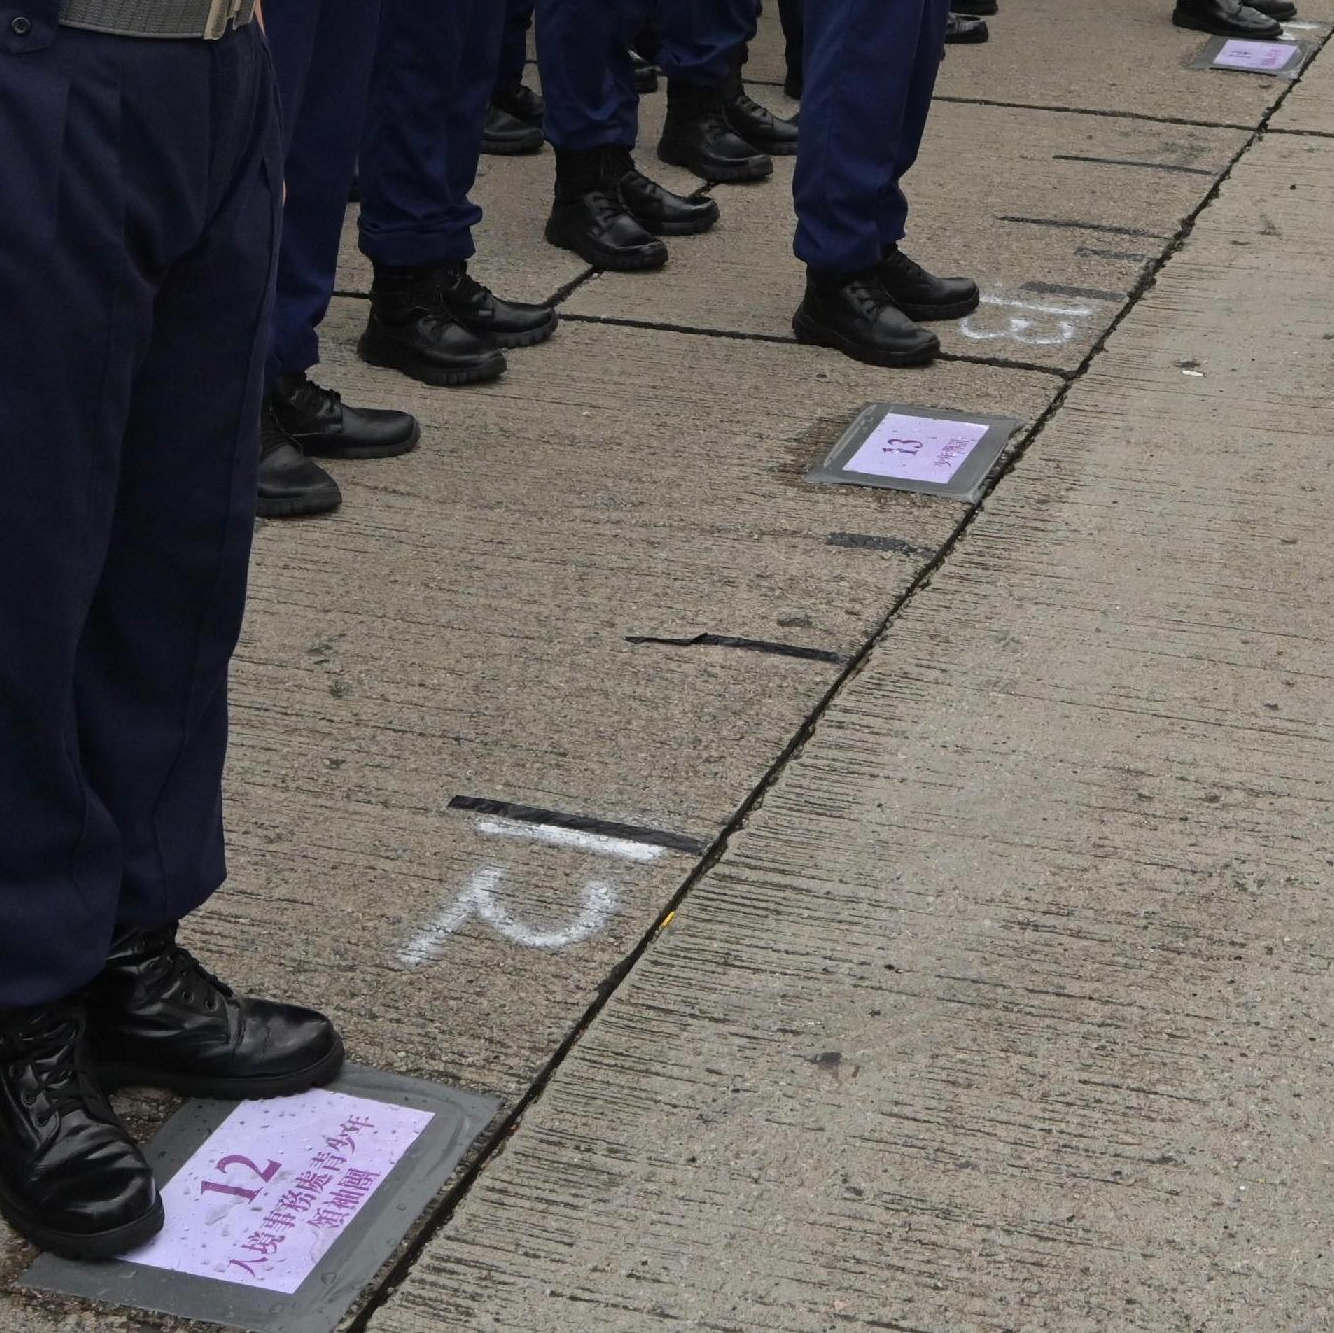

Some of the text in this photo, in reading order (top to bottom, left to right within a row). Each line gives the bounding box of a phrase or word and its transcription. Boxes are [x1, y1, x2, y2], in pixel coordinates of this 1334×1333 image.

[882, 438, 923, 456] 13
[200, 1153, 283, 1205] 12
[228, 1113, 375, 1277] 入境事務處青少年
[307, 1168, 382, 1230] 領袖團
